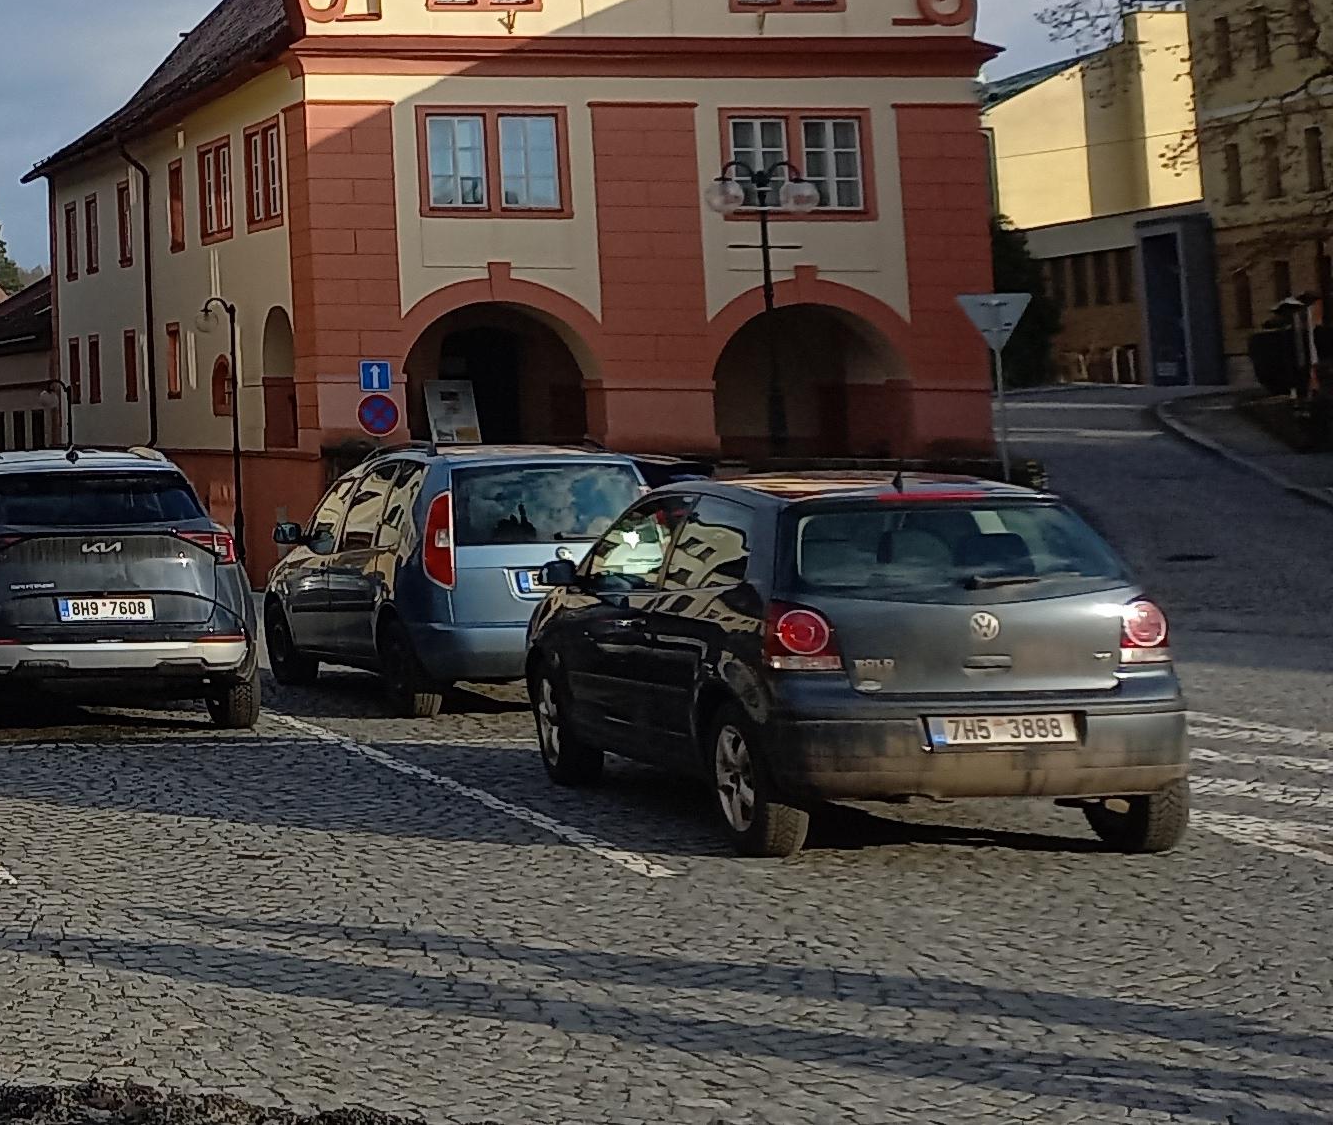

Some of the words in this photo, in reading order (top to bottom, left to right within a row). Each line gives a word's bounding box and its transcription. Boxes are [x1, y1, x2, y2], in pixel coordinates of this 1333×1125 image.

[72, 601, 99, 616] 8H9
[109, 601, 146, 615] 7608
[947, 719, 992, 741] 7H5
